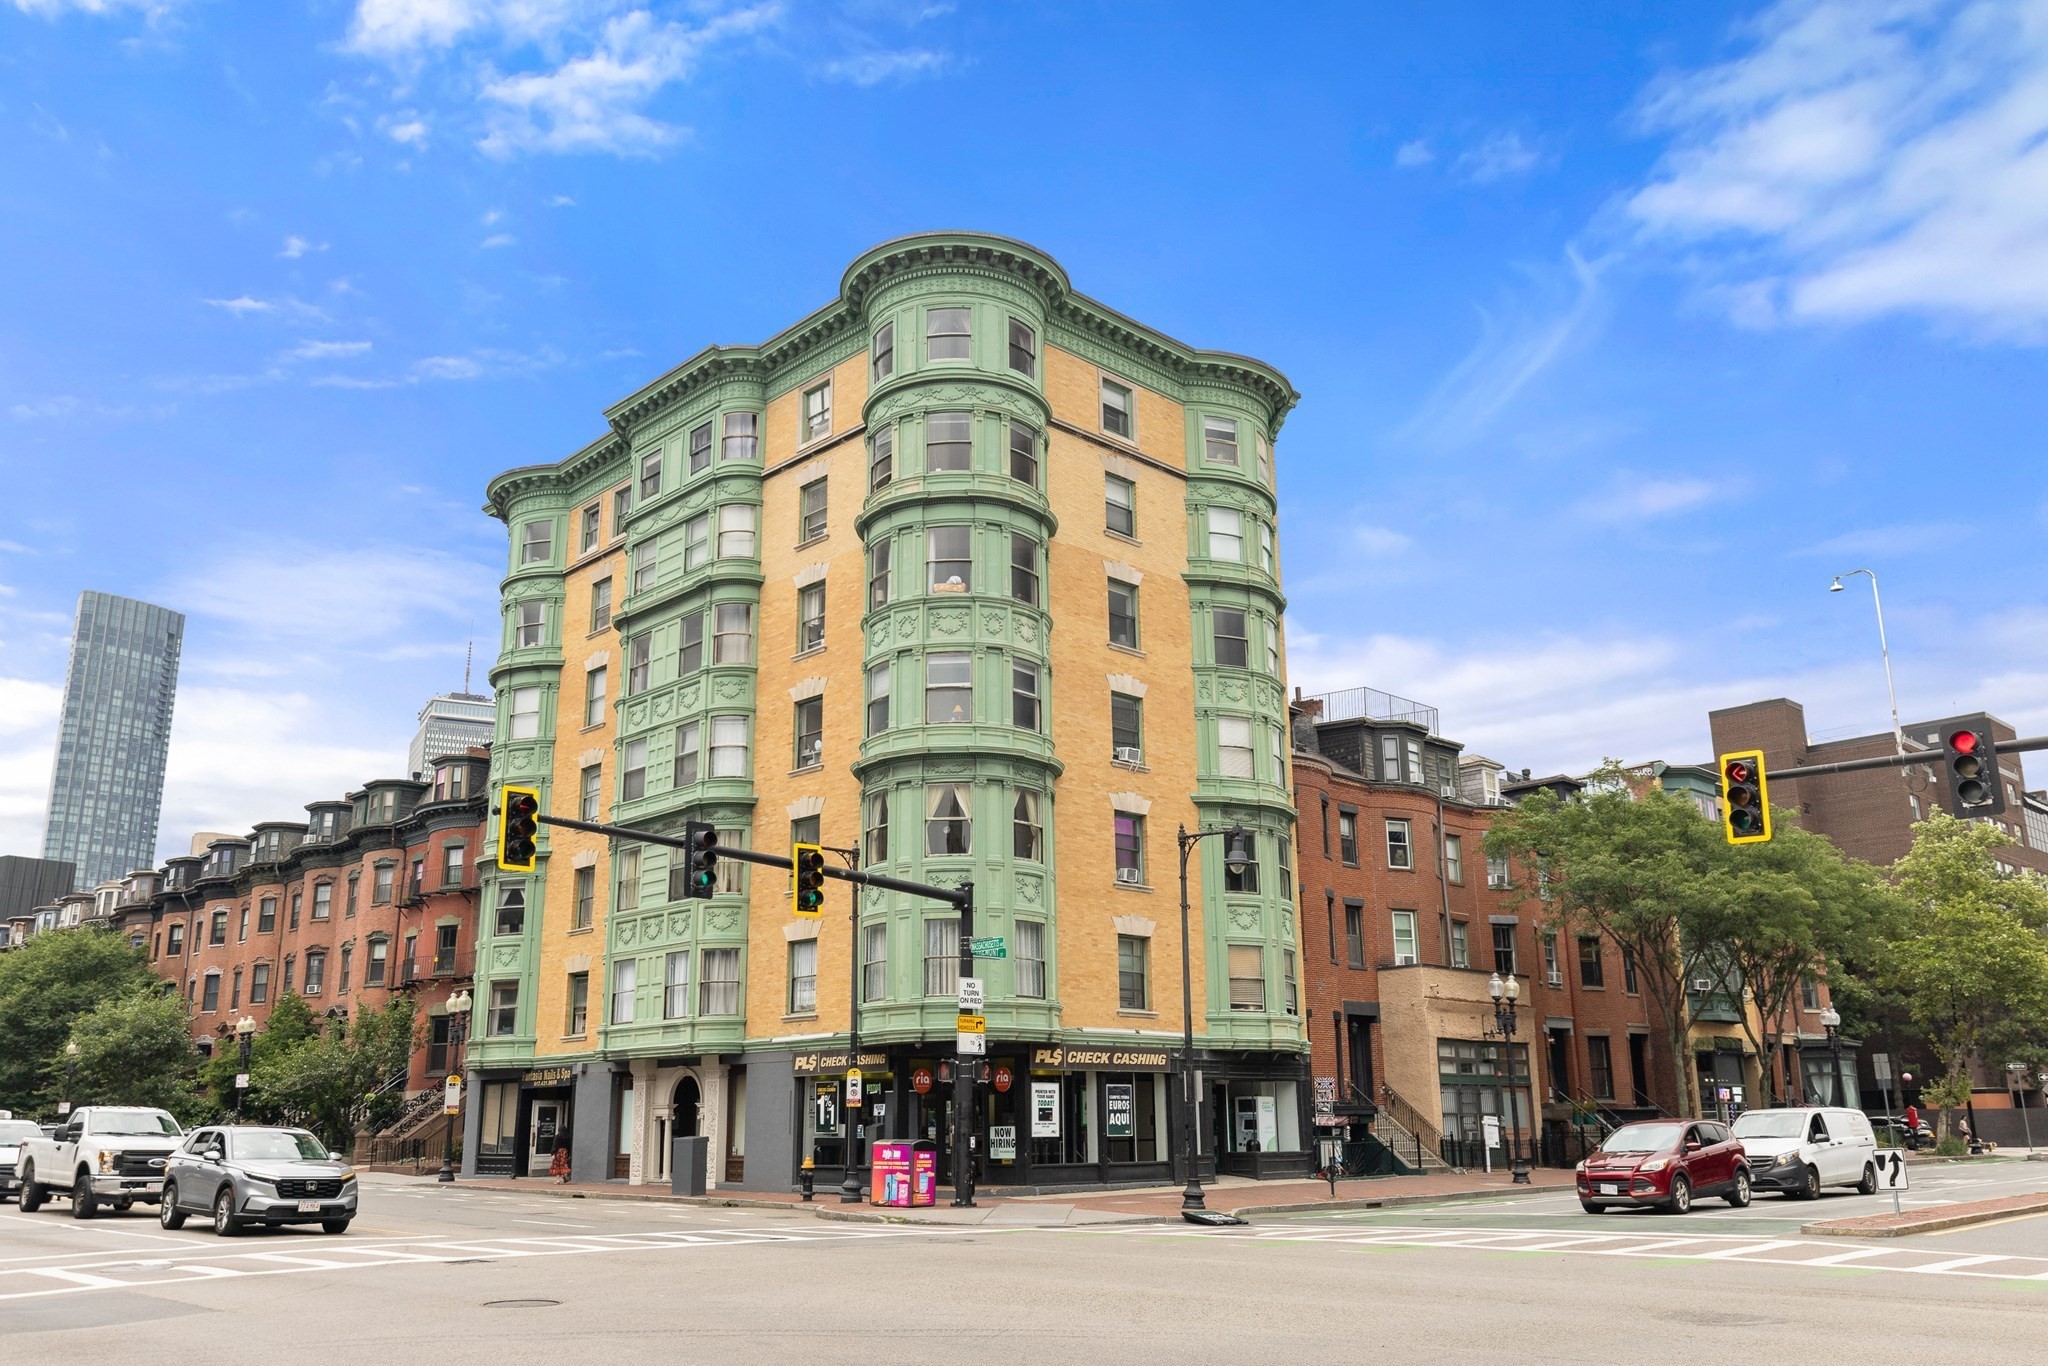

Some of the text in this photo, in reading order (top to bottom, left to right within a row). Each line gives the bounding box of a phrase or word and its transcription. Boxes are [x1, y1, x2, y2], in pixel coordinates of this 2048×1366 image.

[820, 1055, 848, 1068] CHECK
[1067, 1051, 1111, 1065] CHECK
[1112, 1052, 1167, 1066] CASHING
[522, 1071, 542, 1081] Fantasia
[543, 1069, 556, 1080] Nails
[561, 1068, 571, 1081] Spa
[915, 1072, 930, 1084] ria
[996, 1070, 1009, 1083] ria
[1037, 1099, 1055, 1107] TODAY!
[1109, 1101, 1130, 1110] EUROS
[1109, 1111, 1130, 1125] AQUÍ
[994, 1127, 1012, 1138] NOW
[990, 1138, 1016, 1149] HIRING
